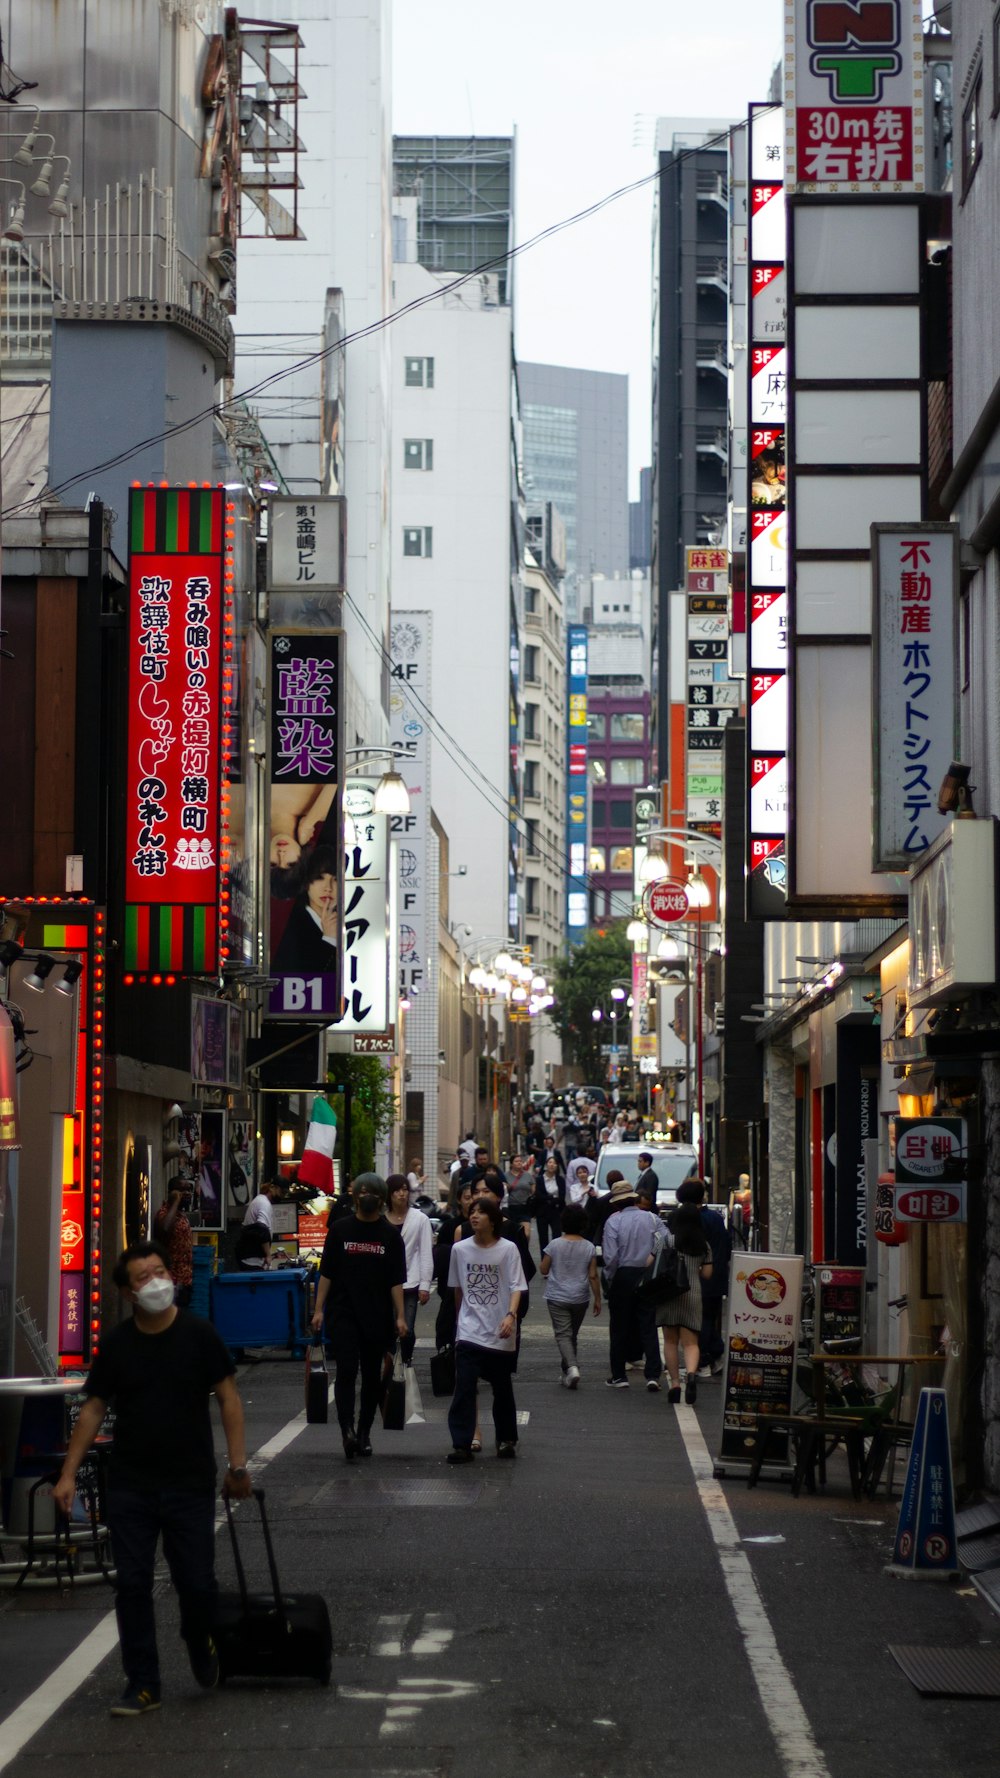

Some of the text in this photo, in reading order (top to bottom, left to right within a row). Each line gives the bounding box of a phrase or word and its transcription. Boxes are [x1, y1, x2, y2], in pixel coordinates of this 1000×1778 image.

[808, 110, 903, 141] 30m先
[804, 142, 902, 181] 右折
[755, 189, 772, 202] 3F
[755, 269, 772, 283] 3F
[754, 350, 771, 364] 3F
[754, 432, 771, 445] 2F
[754, 513, 772, 526] 2F
[691, 551, 725, 568] 麻雀
[900, 541, 931, 634] 不動産
[754, 595, 771, 608] 2F
[391, 664, 418, 679] 4F
[754, 677, 771, 690] 2F
[276, 657, 336, 777] 藍染
[902, 640, 932, 853] ホクトシステム
[754, 760, 769, 773] B1
[391, 816, 416, 832] 2F
[754, 842, 769, 855] B1
[179, 855, 210, 865] RED
[653, 895, 686, 910] 消火栓
[283, 977, 323, 1010] B1
[466, 1263, 499, 1273] LOEWE
[67, 1288, 78, 1332] 歌舞伎町
[929, 1464, 944, 1525] 駐車禁止
